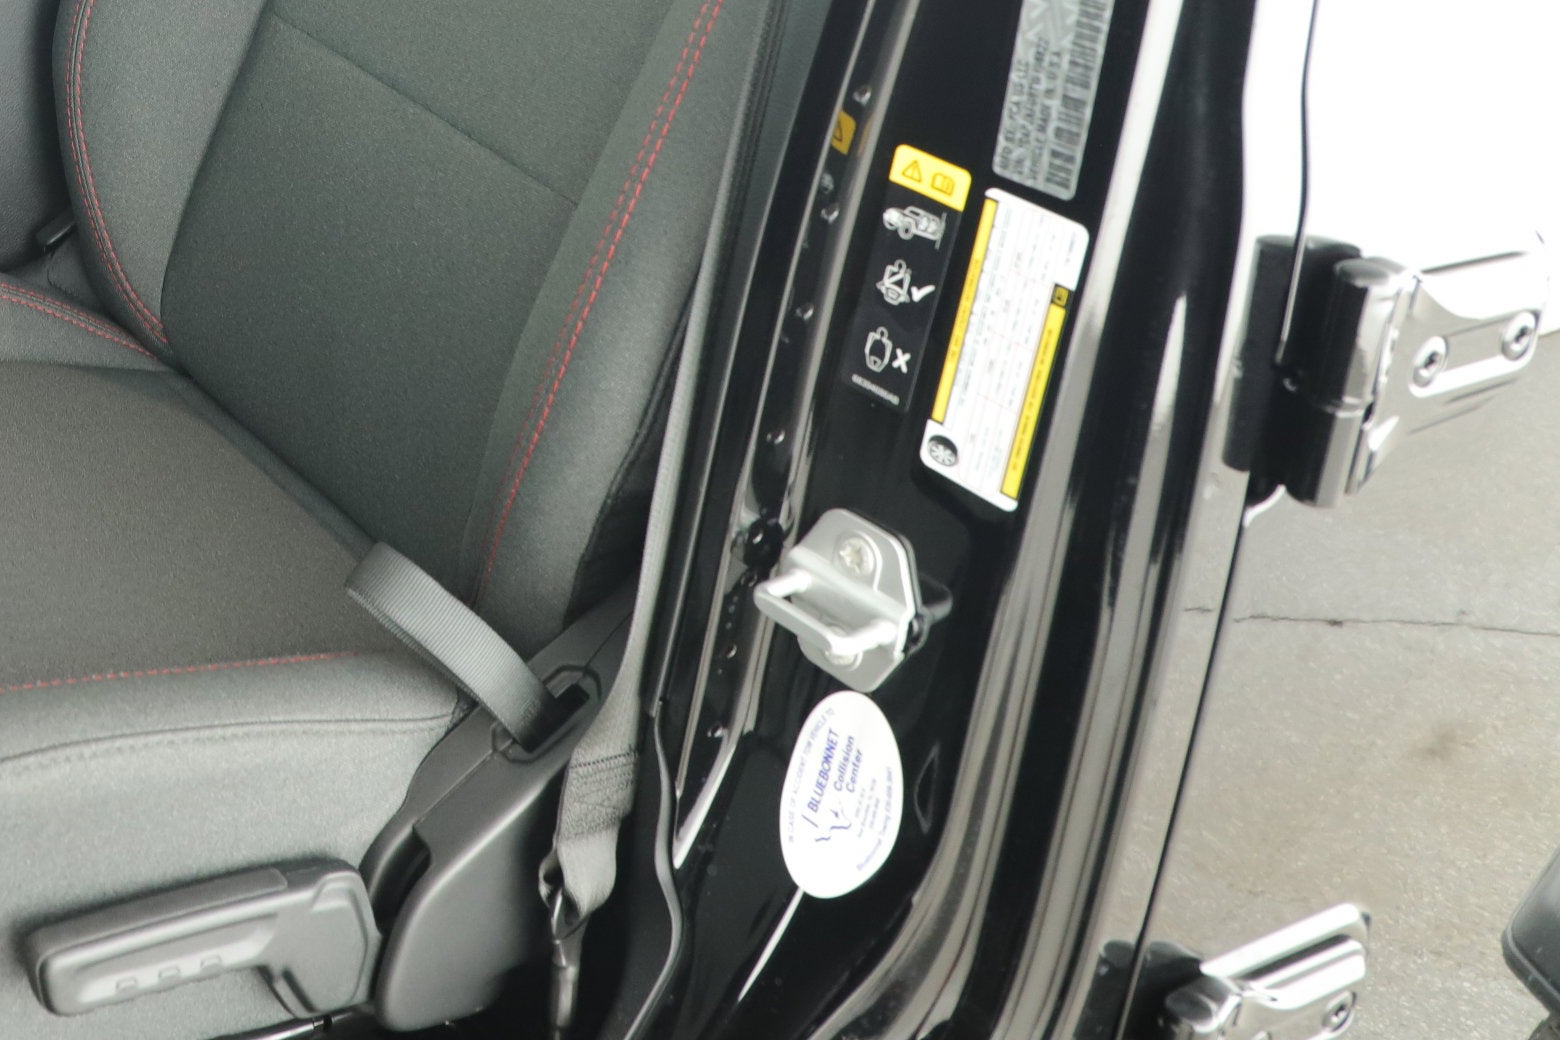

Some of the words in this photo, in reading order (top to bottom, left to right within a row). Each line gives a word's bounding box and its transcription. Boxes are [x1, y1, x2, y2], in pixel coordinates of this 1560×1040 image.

[807, 728, 840, 813] BLUEBONNET
[833, 735, 854, 792] Collision
[845, 748, 863, 793] Center
